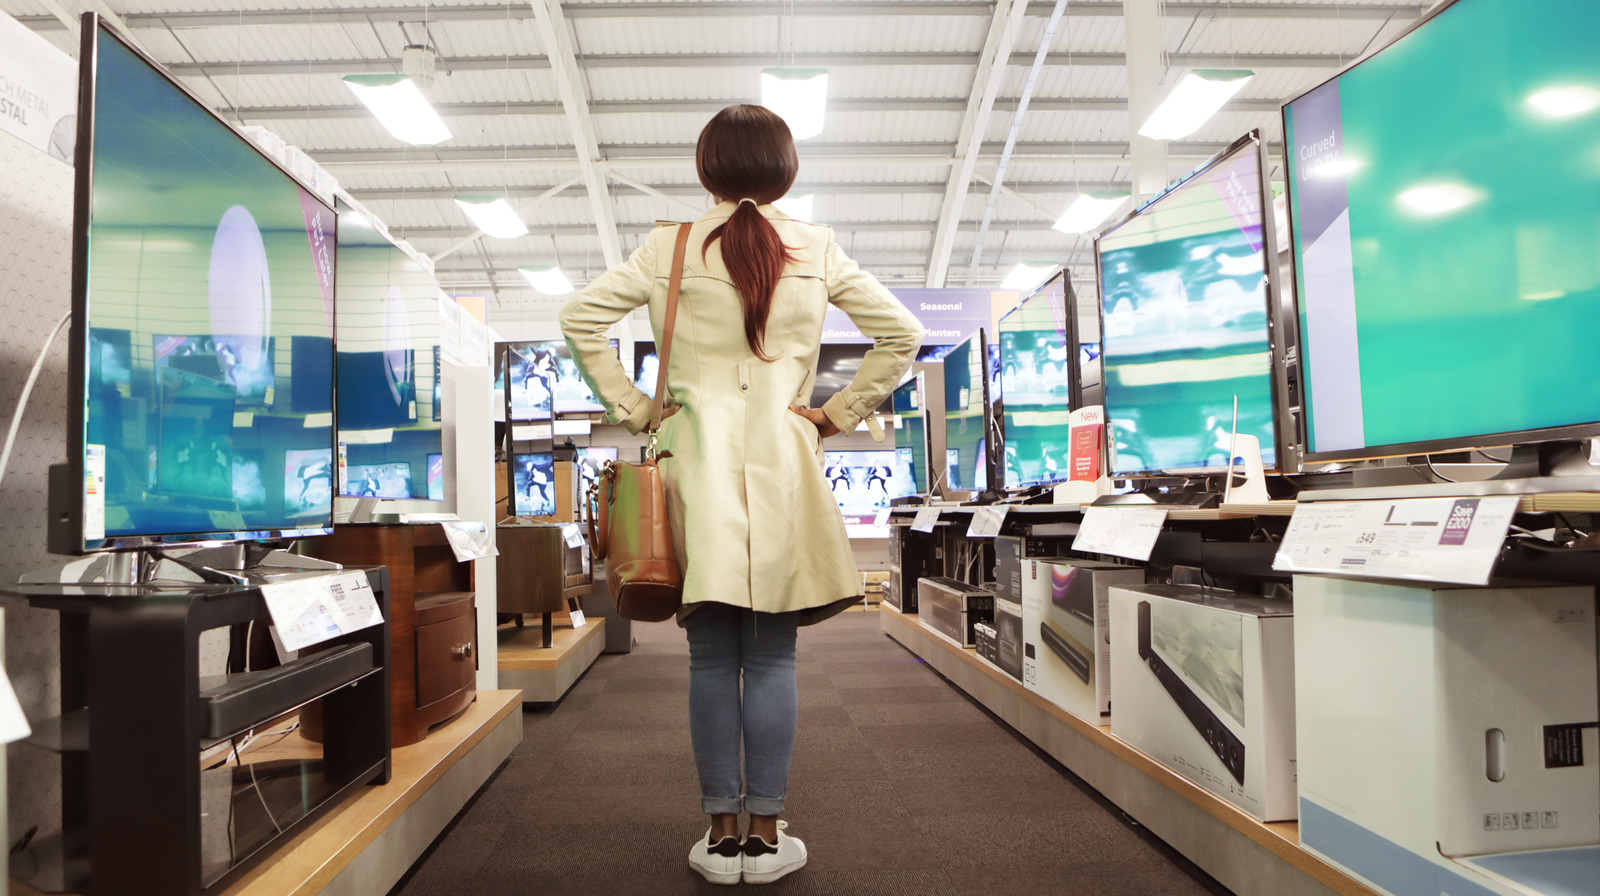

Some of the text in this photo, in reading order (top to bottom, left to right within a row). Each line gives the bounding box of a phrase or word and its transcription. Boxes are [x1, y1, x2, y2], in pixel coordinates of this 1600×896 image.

[16, 85, 50, 119] METAL
[0, 97, 28, 126] STAL
[1300, 130, 1336, 161] Curved
[920, 302, 962, 311] Seasonal
[822, 328, 861, 339] pliances
[1081, 411, 1099, 422] New
[1452, 505, 1474, 517] Save
[1446, 517, 1471, 529] £200
[1355, 532, 1377, 544] £549
